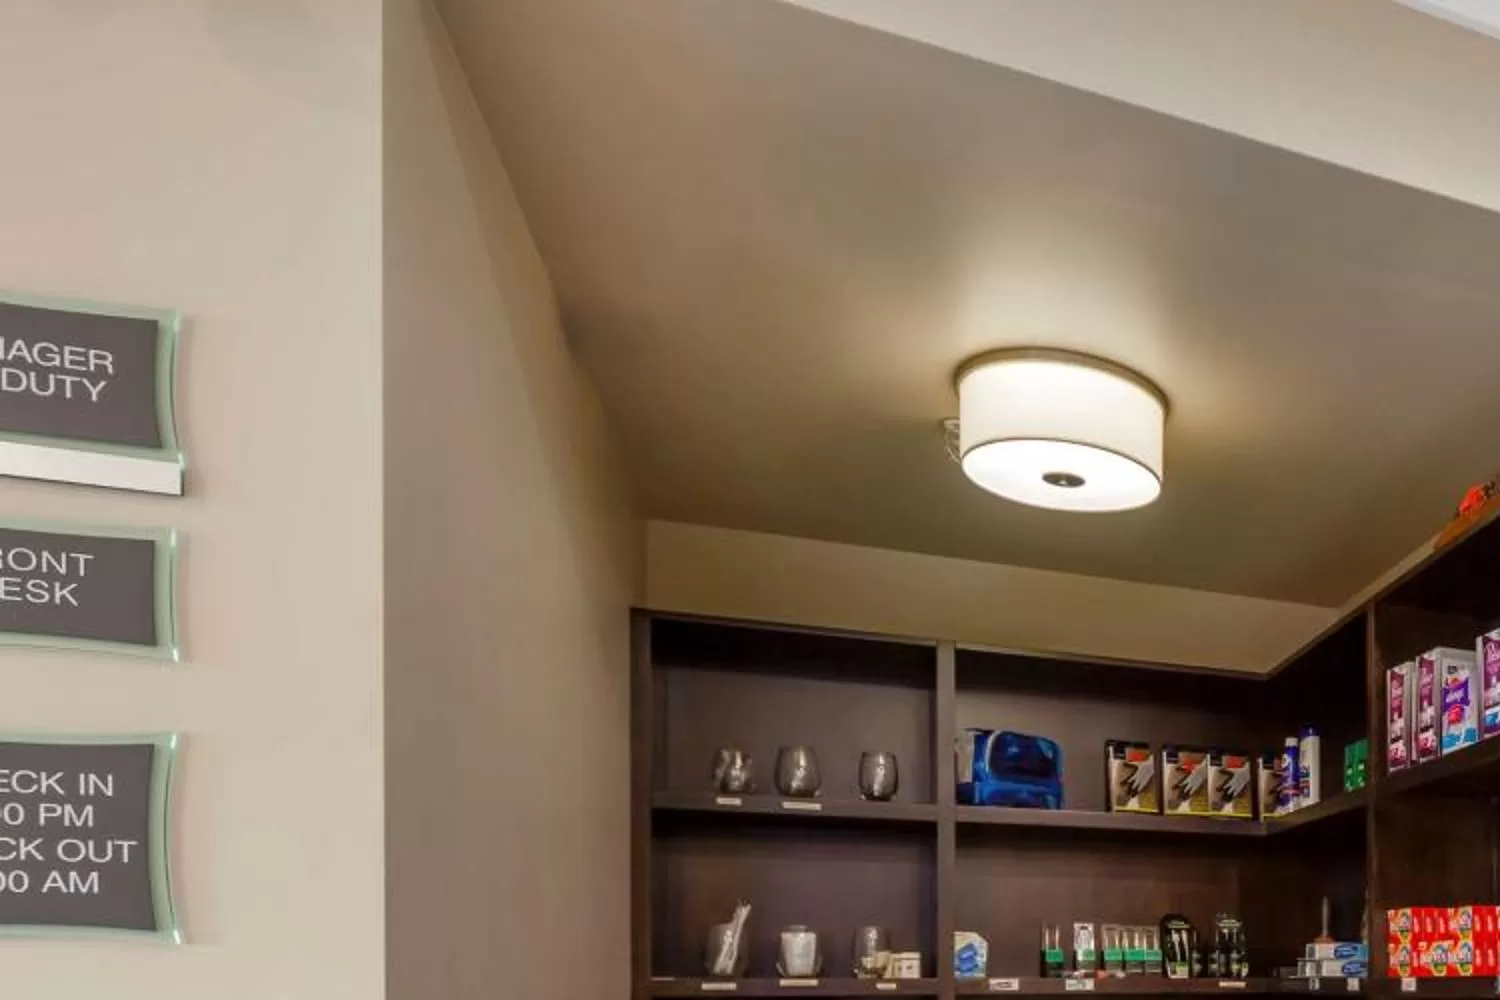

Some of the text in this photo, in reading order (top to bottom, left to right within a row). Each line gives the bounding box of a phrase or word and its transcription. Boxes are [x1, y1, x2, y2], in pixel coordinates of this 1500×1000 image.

[0, 336, 113, 375] AGER
[1, 367, 107, 402] DUTY
[0, 547, 95, 577] ONT
[79, 773, 113, 796] IN
[39, 803, 94, 827] PM
[57, 839, 139, 863] OUT
[41, 870, 99, 894] AM
